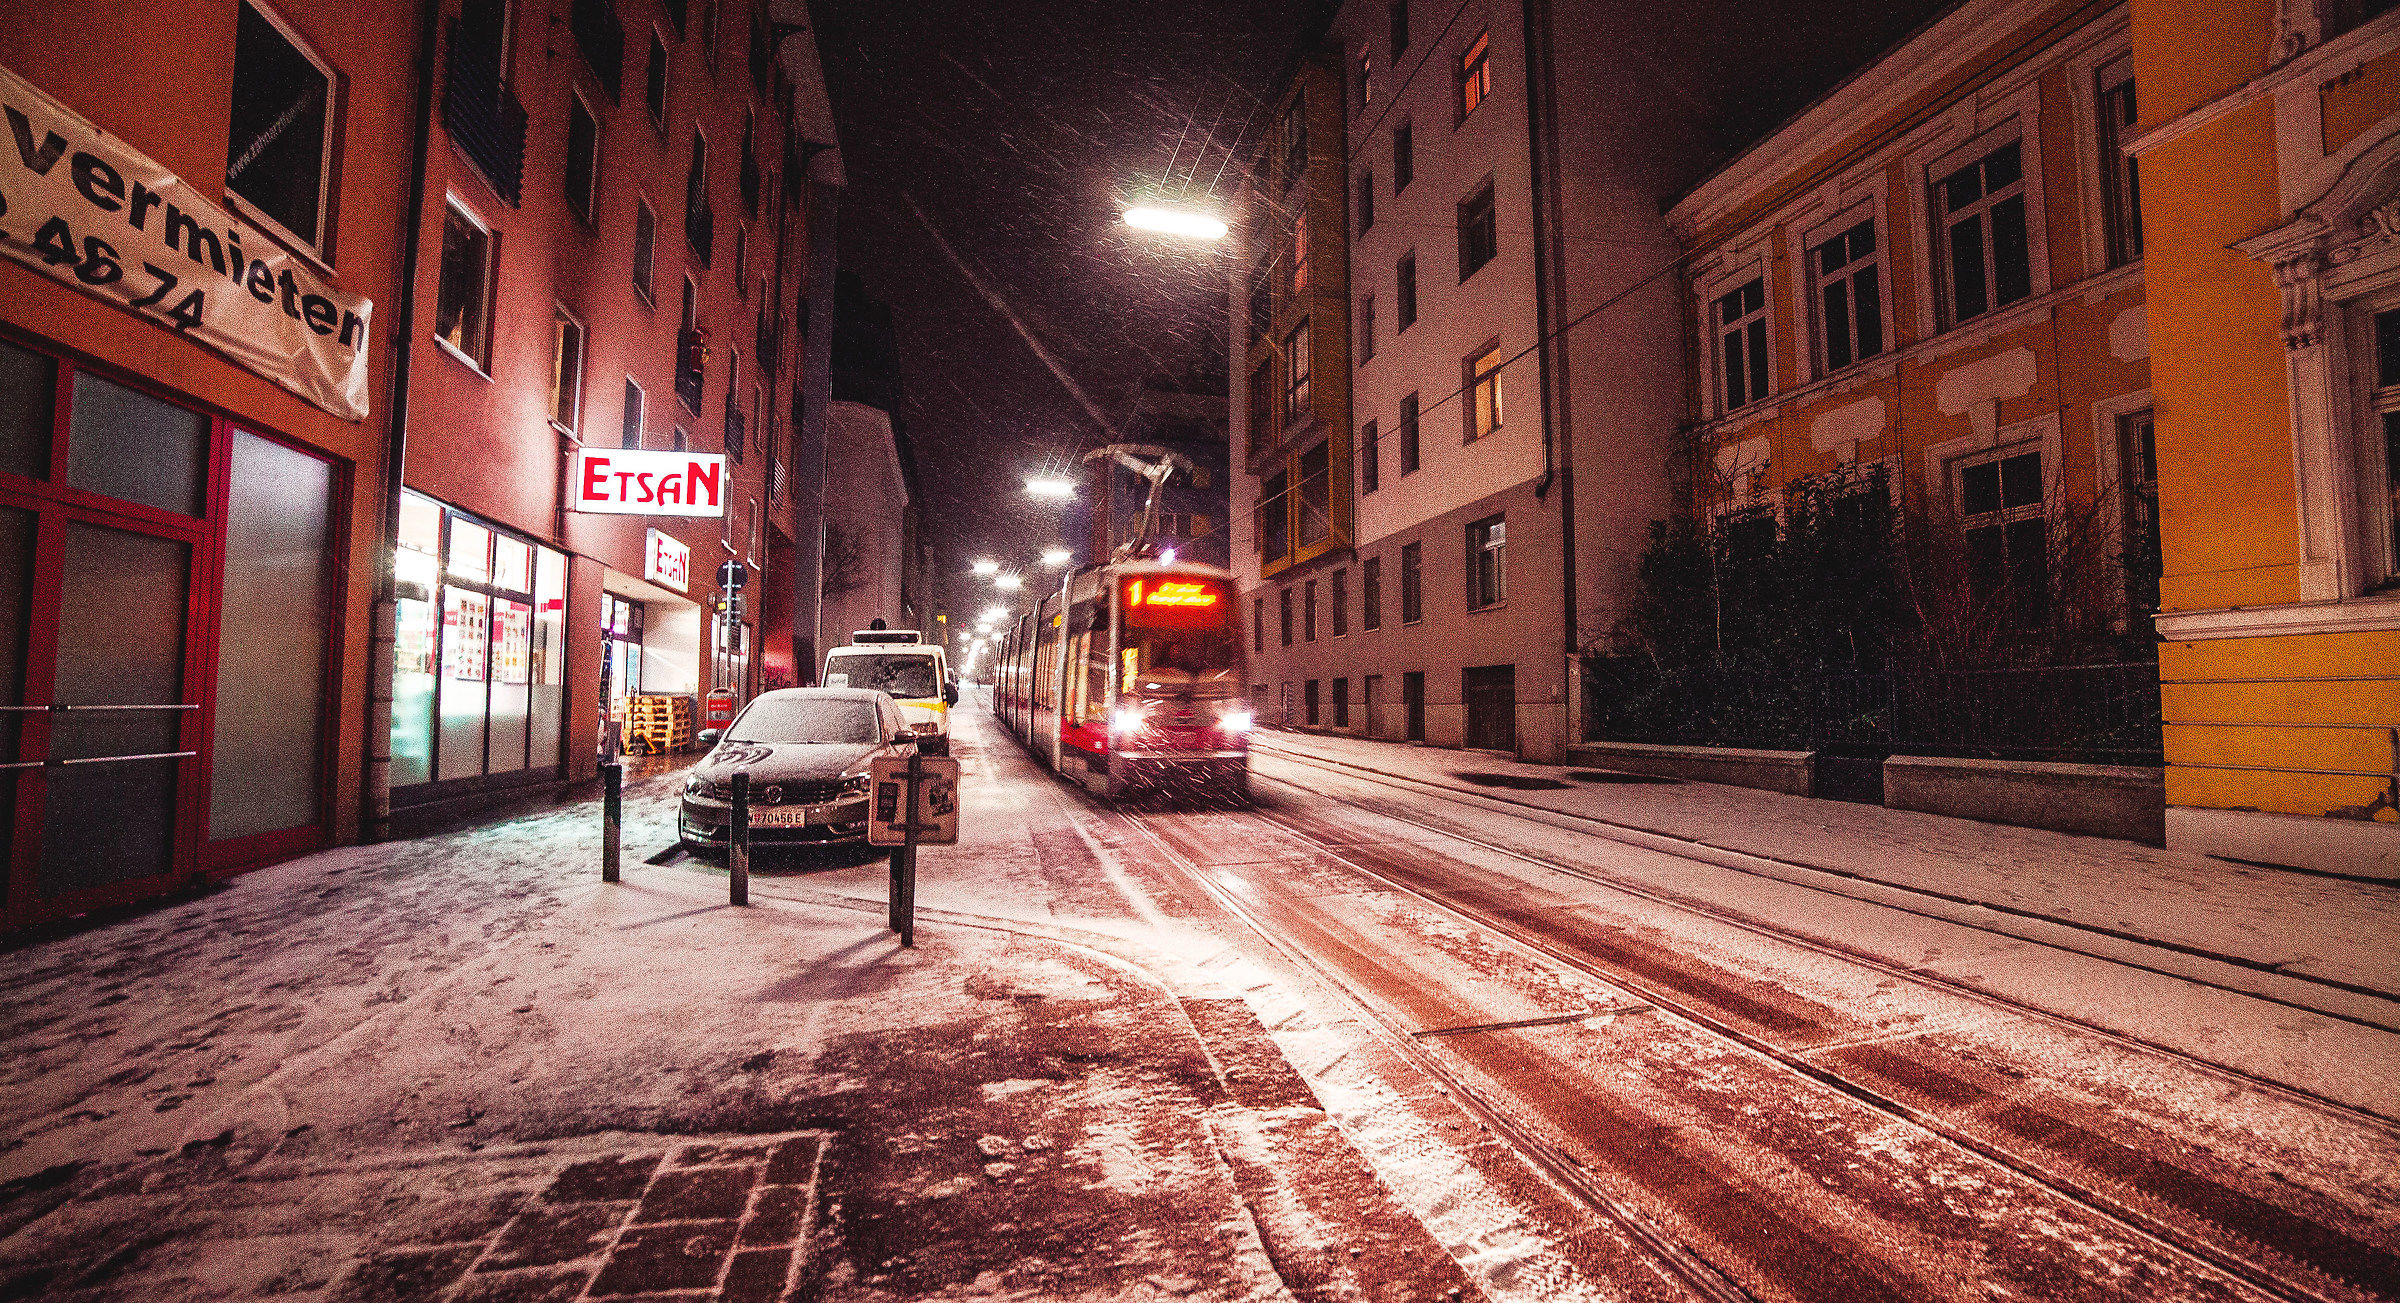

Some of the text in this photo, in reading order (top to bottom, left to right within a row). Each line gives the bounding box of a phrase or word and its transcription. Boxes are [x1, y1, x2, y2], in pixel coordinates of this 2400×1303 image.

[3, 104, 365, 352] vermieten
[32, 215, 123, 285] 46
[129, 261, 205, 329] 74
[1129, 580, 1143, 607] 1
